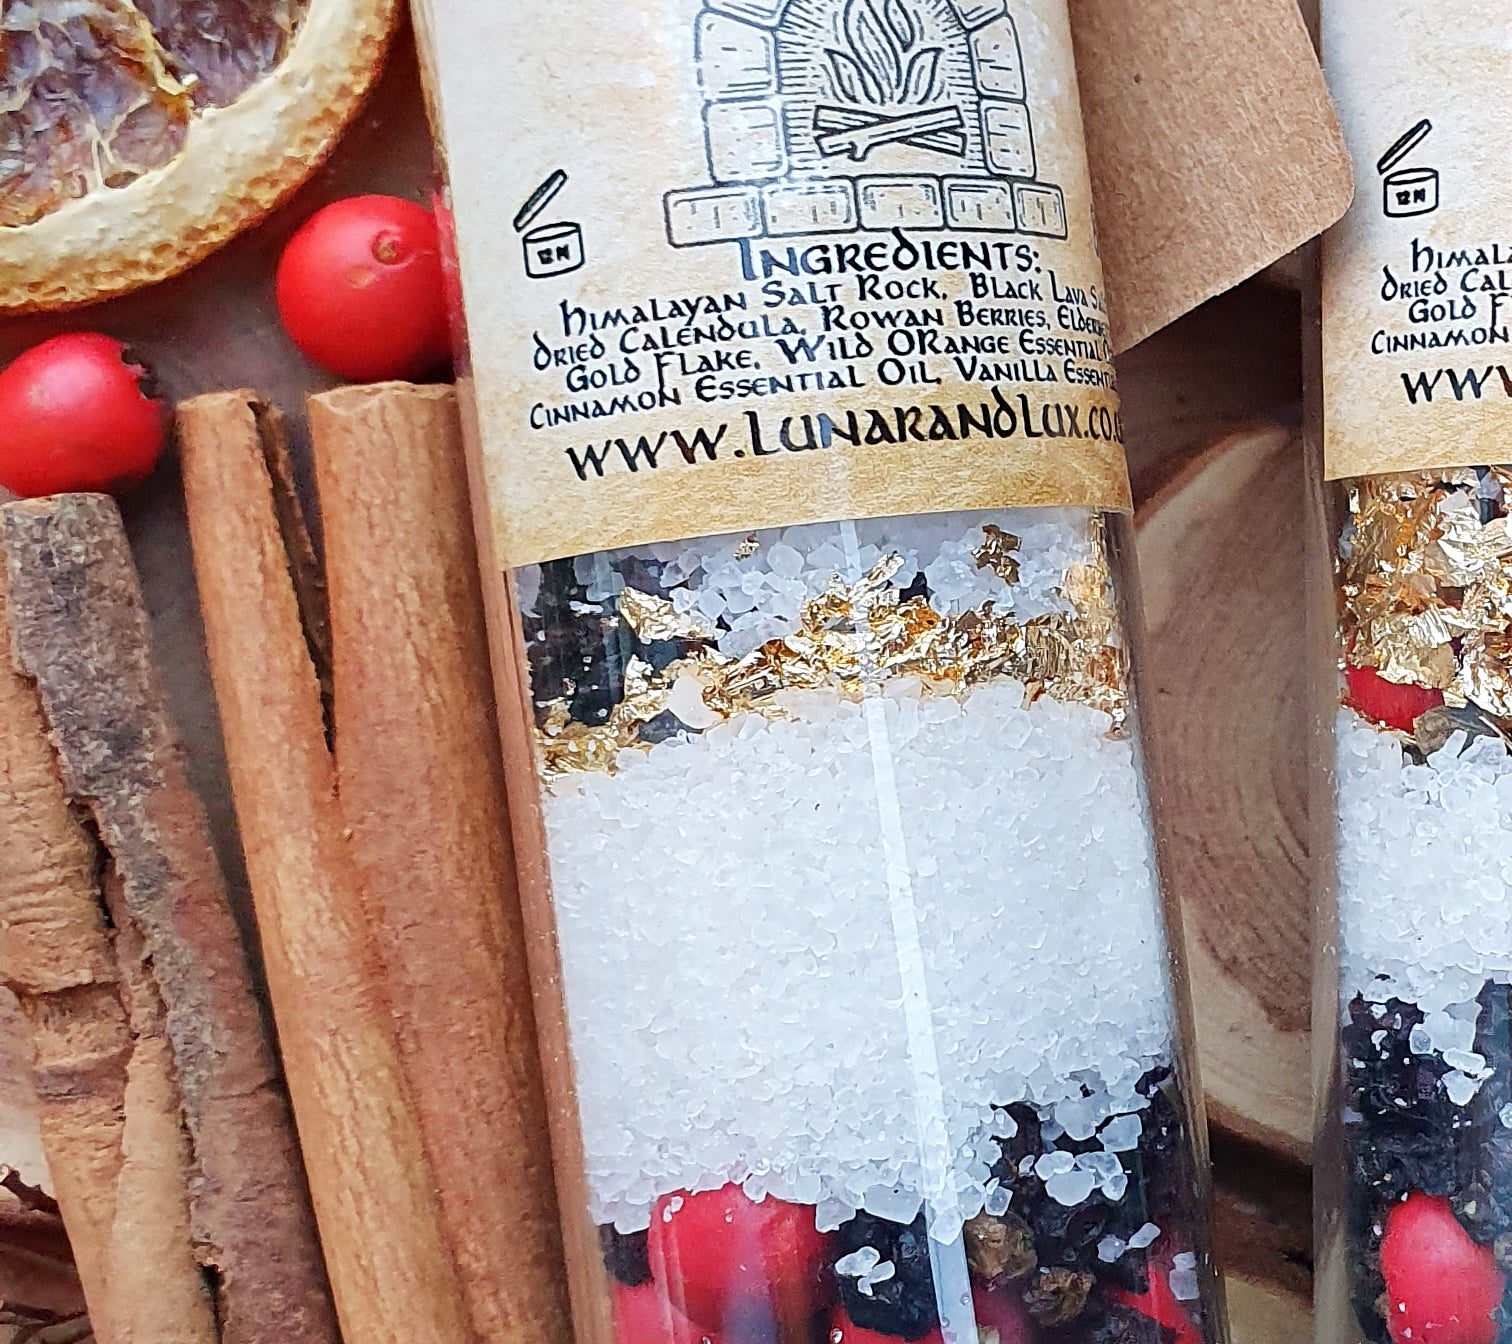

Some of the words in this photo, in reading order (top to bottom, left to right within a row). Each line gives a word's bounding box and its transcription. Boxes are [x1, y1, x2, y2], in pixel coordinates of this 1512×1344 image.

[734, 227, 1042, 280] Ingredients:
[559, 292, 747, 337] Himalayan
[761, 280, 842, 307] Salt
[969, 272, 1043, 301] Black
[1047, 269, 1088, 307] Lava
[822, 305, 944, 331] Rowan
[954, 300, 1051, 330] Berries,
[1409, 295, 1476, 323] Gold
[566, 357, 641, 392] Gold
[775, 331, 873, 364] Wild
[1019, 329, 1102, 361] Essential
[1371, 326, 1509, 354] Cinnamon
[530, 387, 681, 429] Cinnamon
[695, 365, 865, 402] Essential
[953, 356, 1058, 382] Vanilla
